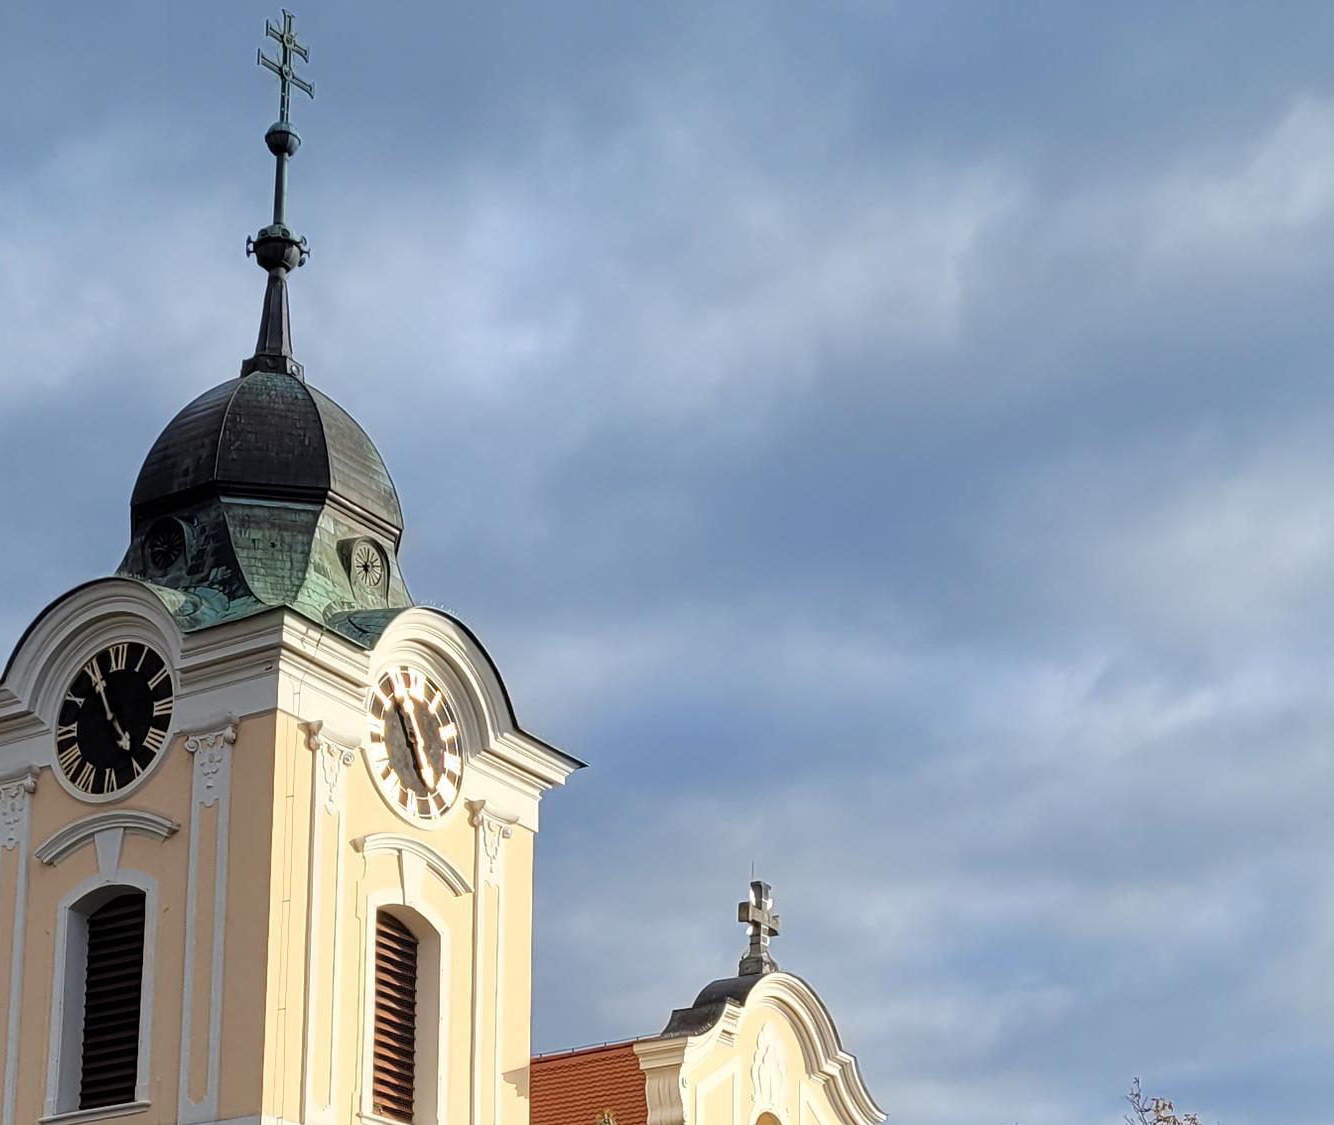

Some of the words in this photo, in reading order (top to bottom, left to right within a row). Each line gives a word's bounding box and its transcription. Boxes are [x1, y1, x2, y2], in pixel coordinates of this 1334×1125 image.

[109, 644, 128, 672] XII
[134, 646, 149, 672] I
[147, 664, 171, 690] II
[65, 690, 86, 708] X
[153, 696, 174, 717] III
[57, 721, 78, 741] IX
[142, 726, 167, 753] IIII
[59, 742, 82, 780] VIII
[131, 757, 144, 779] V
[75, 761, 96, 793] VII
[104, 768, 117, 793] VI
